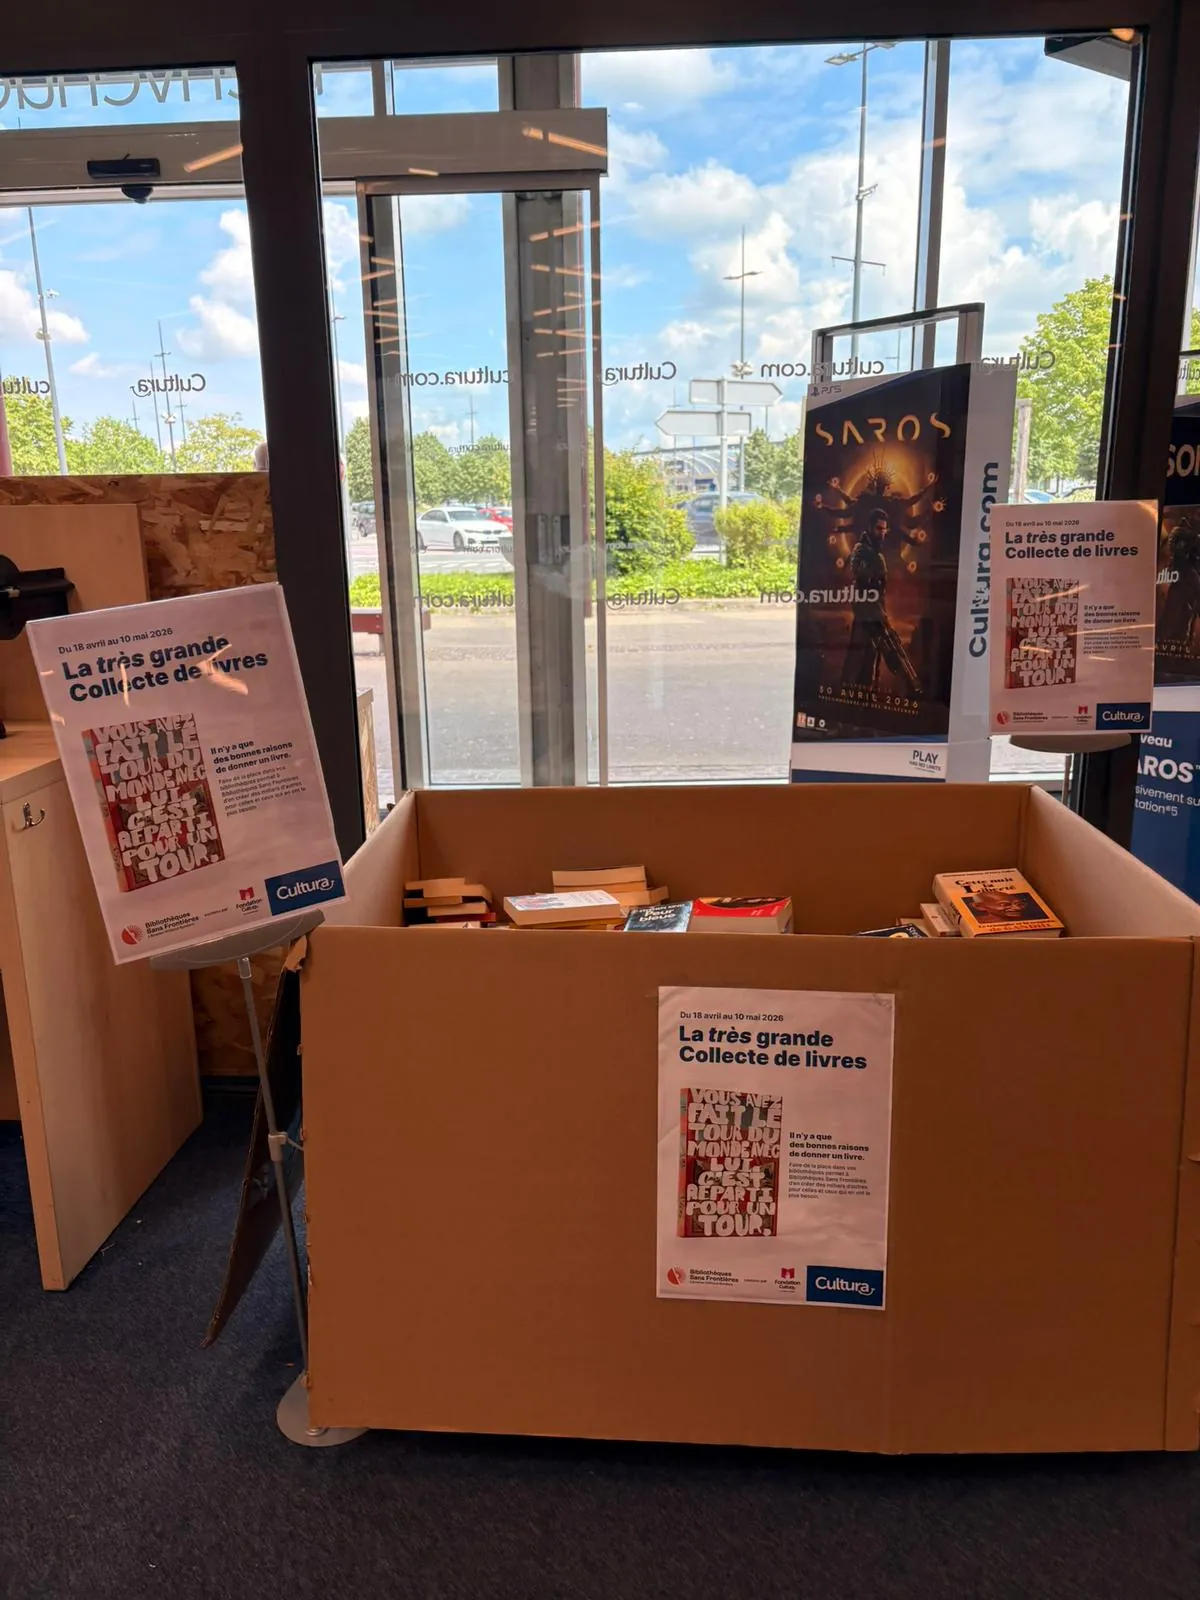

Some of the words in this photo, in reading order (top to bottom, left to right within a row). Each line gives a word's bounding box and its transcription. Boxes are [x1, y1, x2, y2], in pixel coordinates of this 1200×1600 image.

[821, 385, 841, 395] PS5
[815, 412, 951, 446] SAROS
[1006, 532, 1022, 544] La
[1026, 531, 1056, 544] très
[1061, 530, 1114, 545] grande
[1006, 547, 1069, 559] Collecte
[1073, 546, 1092, 557] de
[1095, 545, 1138, 557] livres
[73, 644, 84, 652] 18
[86, 639, 106, 650] avril
[120, 635, 130, 644] 10
[133, 632, 149, 641] mai
[150, 628, 173, 639] 2026
[62, 661, 92, 680] La
[97, 651, 145, 674] très
[149, 636, 230, 668] grande
[69, 671, 169, 702] Collecte
[174, 664, 202, 682] de
[1102, 711, 1144, 722] Cultura
[96, 719, 150, 743] VOUS
[156, 713, 196, 734] AVEZ
[96, 734, 158, 766] FAIT
[166, 728, 200, 752] LE
[230, 750, 261, 760] bonnes
[263, 742, 292, 753] raisons
[238, 741, 254, 749] que
[101, 755, 163, 784] TOUR
[167, 748, 201, 769] DU
[912, 750, 939, 764] PLAY
[216, 766, 226, 774] de
[228, 760, 257, 770] donner
[106, 769, 175, 802] MONDE
[118, 812, 212, 851] REPARTI
[121, 837, 180, 867] POUR
[187, 826, 218, 846] UN
[139, 843, 219, 883] TOUR.
[276, 877, 335, 900] Cultura
[145, 912, 191, 929] Bibliothèques
[147, 925, 163, 935] Sans
[164, 916, 199, 931] Frontières
[680, 1011, 691, 1019] Du
[762, 1014, 784, 1022] 2026
[679, 1025, 704, 1042] La
[709, 1026, 751, 1044] très
[756, 1030, 834, 1049] grande
[679, 1046, 769, 1065] Collecte
[774, 1050, 801, 1067] de
[805, 1050, 867, 1069] livres
[690, 1088, 740, 1105] VOUS
[746, 1093, 782, 1109] AVEZ
[688, 1103, 745, 1128] FAIT
[752, 1106, 781, 1128] LE
[688, 1123, 742, 1141] TOUR
[748, 1127, 780, 1144] DU
[796, 1132, 808, 1140] n'y
[687, 1140, 750, 1158] MONDE
[806, 1142, 837, 1150] bonnes
[698, 1172, 765, 1187] C'EST
[686, 1184, 773, 1202] REPARTI
[686, 1200, 740, 1216] POUR
[747, 1202, 776, 1215] UN
[699, 1214, 771, 1237] TOUR.
[690, 1269, 732, 1277] Bibliothèques
[706, 1275, 739, 1283] Frontières
[815, 1276, 875, 1296] Cultura
